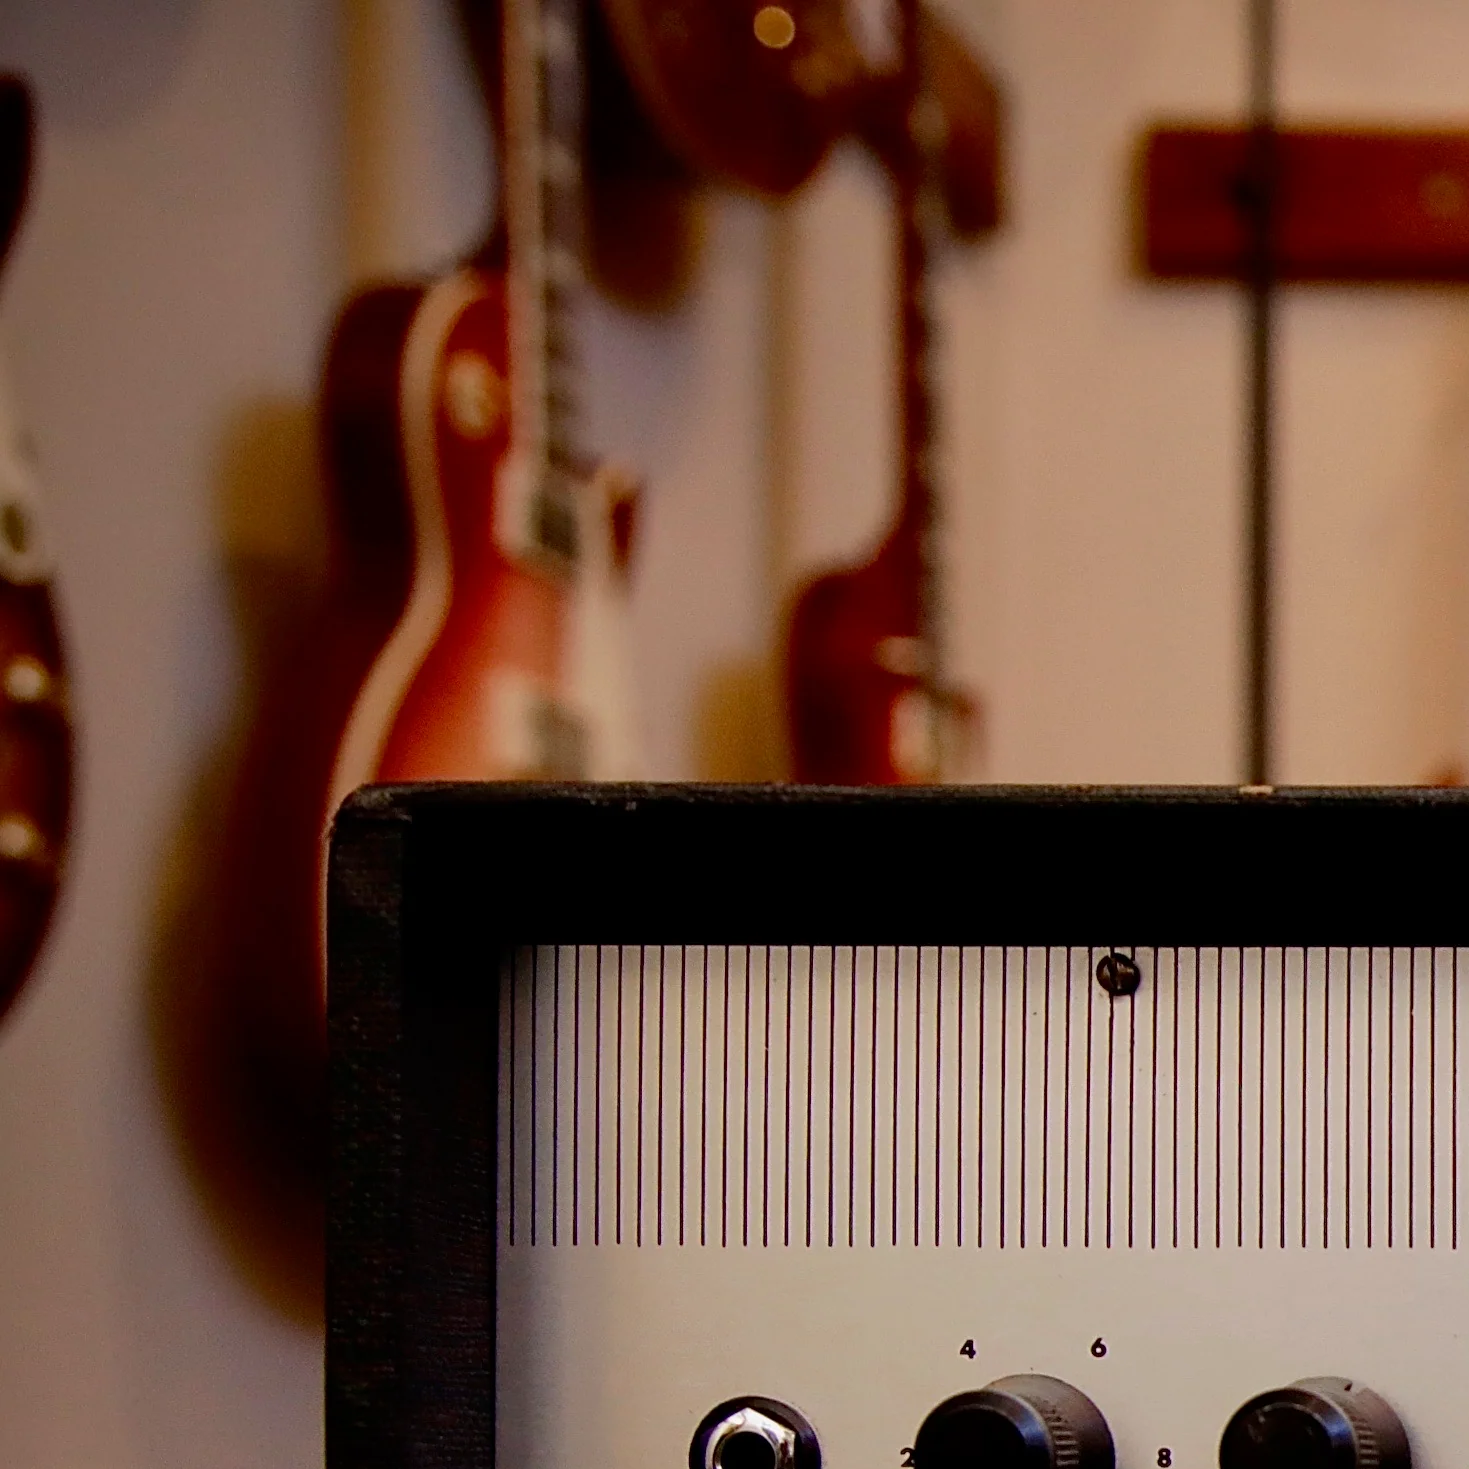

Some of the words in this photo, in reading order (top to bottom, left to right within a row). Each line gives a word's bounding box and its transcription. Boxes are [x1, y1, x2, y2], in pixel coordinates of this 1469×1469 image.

[959, 1339, 977, 1360] 4
[1090, 1337, 1107, 1358] 6
[900, 1447, 916, 1468] 2
[1156, 1447, 1172, 1469] 8
